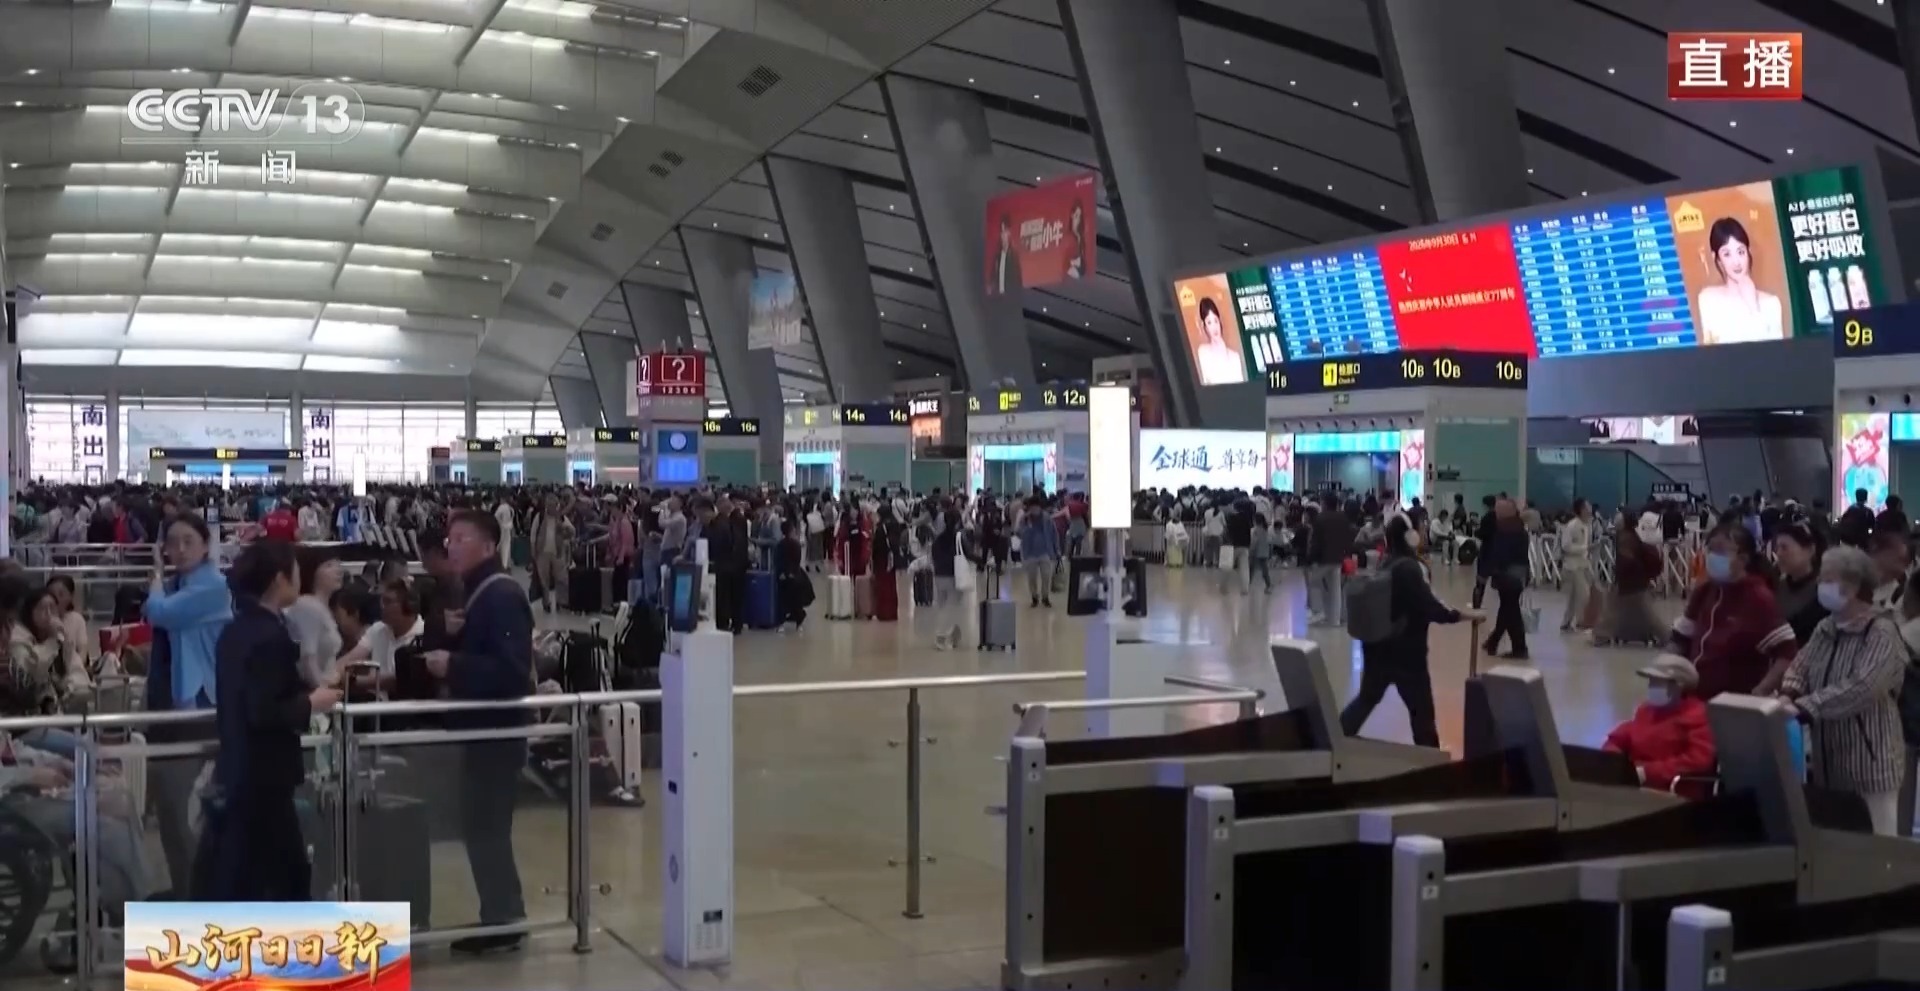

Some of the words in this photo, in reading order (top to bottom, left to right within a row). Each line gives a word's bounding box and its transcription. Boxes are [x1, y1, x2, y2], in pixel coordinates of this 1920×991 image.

[1790, 207, 1860, 239] 更好蛋白
[1795, 233, 1866, 263] 更好吸收
[1844, 320, 1873, 346] 9B
[1401, 358, 1424, 379] 10B
[1432, 357, 1461, 379] 10B
[1496, 361, 1522, 380] 10B
[1268, 370, 1287, 388] 11B
[662, 386, 696, 395] 12306
[1062, 390, 1086, 405] 12B
[845, 409, 866, 422] 14B
[889, 409, 908, 422] 14B
[704, 421, 721, 433] 16B
[741, 422, 757, 433] 16B
[81, 404, 104, 484] 南出口
[310, 406, 331, 483] 南出口
[1150, 444, 1213, 472] 全球通
